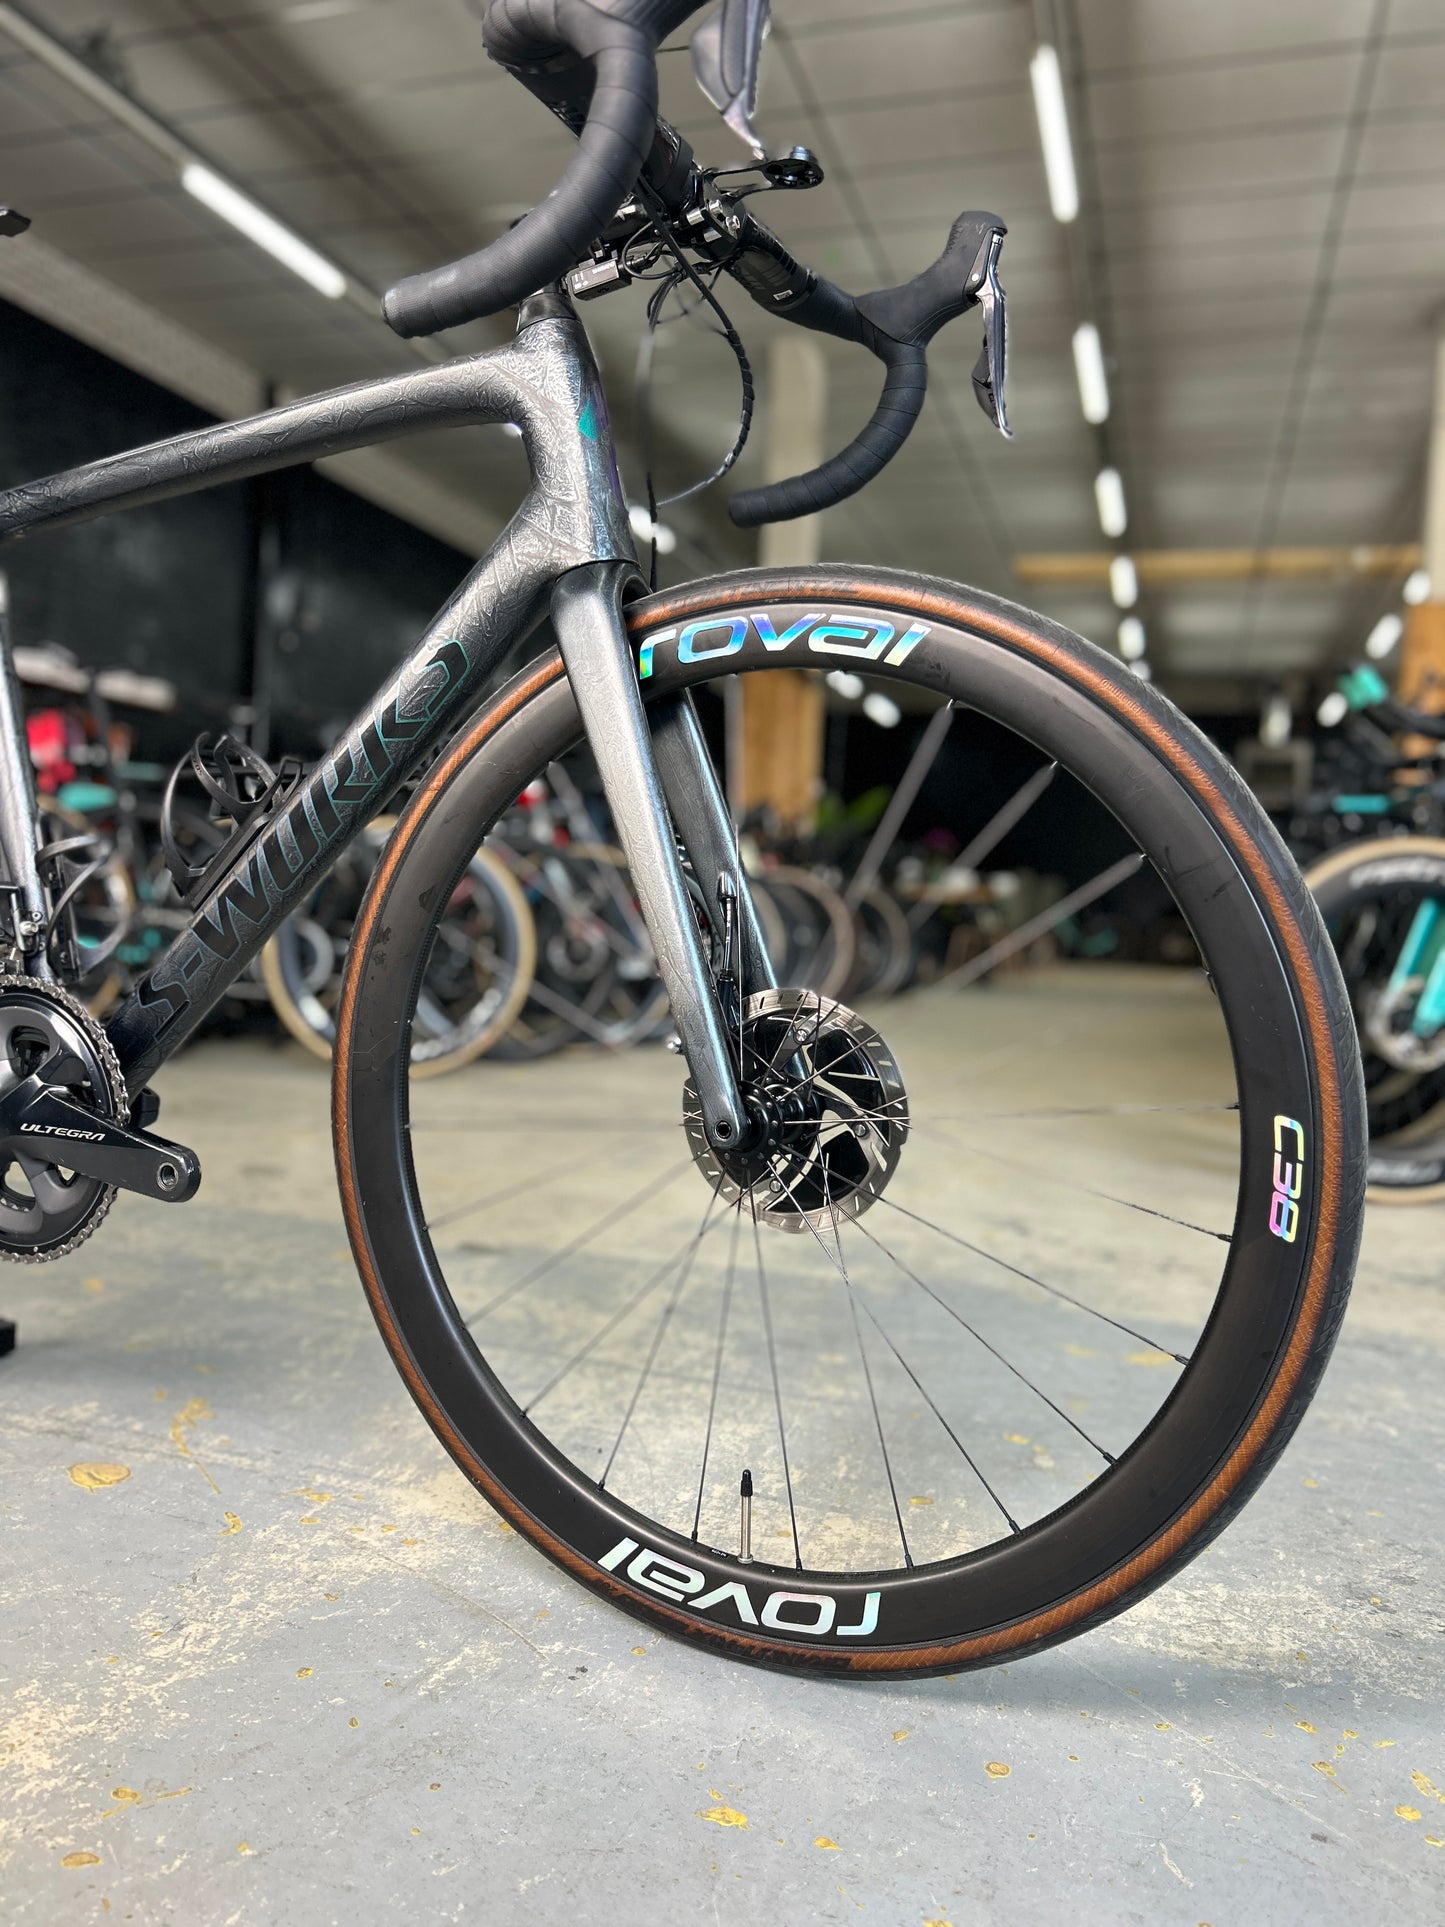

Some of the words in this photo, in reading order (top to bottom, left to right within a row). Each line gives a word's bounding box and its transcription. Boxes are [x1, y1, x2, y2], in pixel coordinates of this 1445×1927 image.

[639, 612, 932, 680] roval
[138, 639, 471, 1043] S-WORKS
[20, 1122, 106, 1141] ULTEGRA
[1268, 1115, 1305, 1243] C38
[597, 1536, 882, 1637] roval
